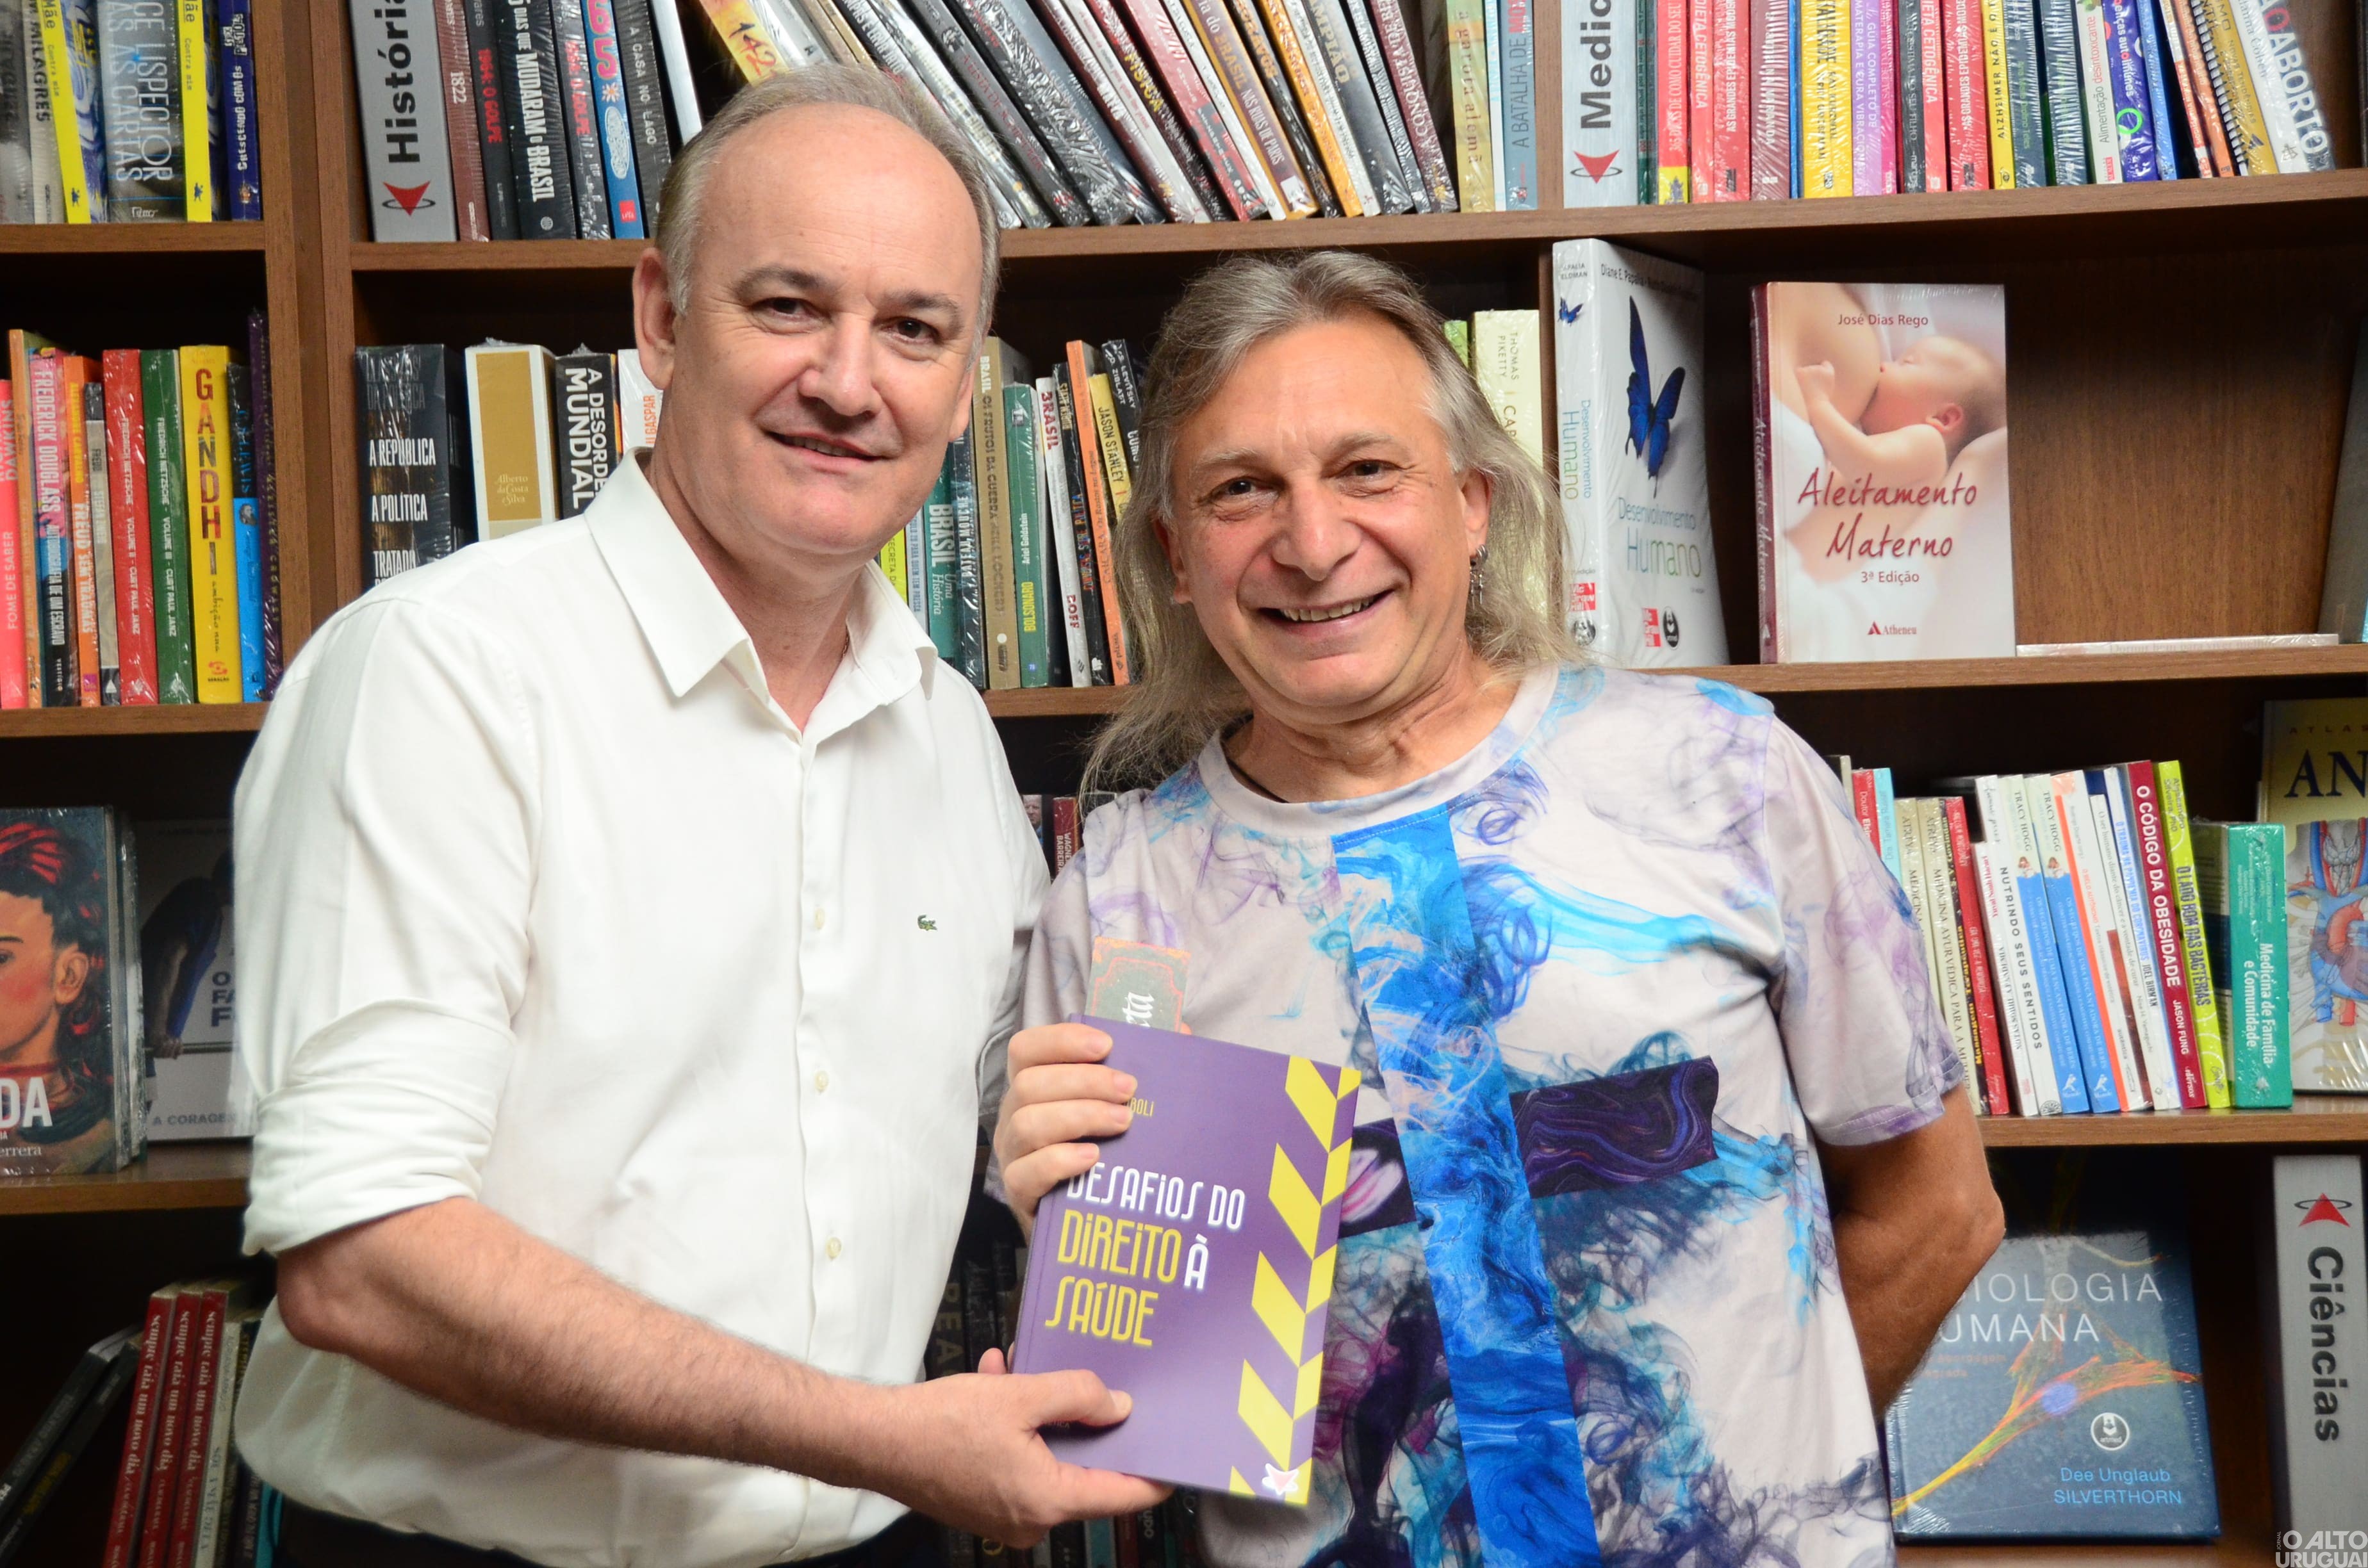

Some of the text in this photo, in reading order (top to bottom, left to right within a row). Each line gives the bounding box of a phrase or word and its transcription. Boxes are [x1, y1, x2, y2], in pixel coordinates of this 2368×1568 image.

[514, 6, 529, 30] DIAS
[1668, 3, 1681, 18] SEU
[1668, 20, 1681, 33] DO
[516, 31, 532, 51] QUE
[1455, 29, 1476, 95] garota
[1668, 36, 1681, 68] CUIDAR
[27, 20, 51, 122] MILAGRES
[373, 0, 421, 165] Históri
[450, 70, 467, 103] 1822
[477, 47, 503, 144] 1964: O GOLPE
[515, 52, 547, 135] MUDARAM
[629, 26, 657, 145] A CASA NO LAGO
[1205, 13, 1286, 166] do BRASIL NAS RUAS DE PARIS
[1508, 38, 1529, 148] A BATALHA DE
[1668, 69, 1681, 95] COMO
[1725, 30, 1736, 131] AS GRANDES EPIDEMIAS
[1866, 22, 1876, 127] GUIA COMPLETO DE
[2085, 15, 2112, 143] Alimentação desintoxicante
[2269, 27, 2330, 156] ABORTO
[135, 43, 173, 181] LISPECTOR
[1668, 98, 1682, 109] DE
[108, 85, 144, 182] CARTAS
[1463, 102, 1484, 164] alemã
[1670, 137, 1682, 151] 365
[526, 144, 555, 202] BRASIL
[1838, 314, 1928, 327] José Dias Rego
[1498, 335, 1507, 377] PIKETTY
[1509, 332, 1519, 380] THOMAS
[33, 370, 56, 441] FREDERICK
[1039, 390, 1060, 450] BRASIL
[2, 400, 17, 480] DAWKINS
[120, 418, 130, 459] FRIEDRICH
[156, 417, 167, 459] FRIEDRICH
[370, 438, 436, 466] A REPÚBLICA
[559, 367, 600, 509] MUNDIAL
[585, 367, 613, 495] A DESORDE
[1098, 405, 1124, 483] JASON STANLEY
[1561, 411, 1583, 500] Humano
[1579, 400, 1595, 498] Desenvolvimento
[38, 445, 60, 512] DOUGLASS
[122, 461, 133, 505] NIETZSCHE
[159, 460, 169, 504] NIETZSCHE
[195, 368, 222, 575] GANDHI
[497, 475, 528, 484] Alberto
[1798, 468, 1977, 506] Aleitamento
[372, 494, 427, 522] A POLÍTICA
[126, 517, 135, 550] VOLUME
[162, 516, 172, 550] VOLUME
[928, 503, 956, 598] BRASIL Uma
[1017, 512, 1032, 564] Ariel Goldstein
[1627, 527, 1702, 578] Humano
[1826, 513, 1953, 561] Materno
[3, 531, 18, 628] FOME DE SABER
[129, 566, 138, 589] CURT
[130, 591, 139, 611] PAUL
[165, 568, 174, 590] CURT
[930, 572, 945, 615] História
[1861, 569, 1920, 585] 3ª Edição
[131, 612, 140, 634] JANZ
[167, 592, 176, 613] PAUL
[168, 614, 177, 636] JANZ
[1019, 581, 1038, 632] BOLSONARO
[50, 611, 65, 645] ESCRAVO
[1883, 625, 1917, 635] Atheneu
[2014, 790, 2032, 851] TRACY HOGG
[2043, 790, 2061, 851] TRACY HOGG
[2178, 874, 2194, 901] LADO
[2135, 785, 2190, 1055] O CÓDIGO DA OBESIDADE JASON FUNG
[2182, 903, 2199, 926] BOM
[2185, 927, 2202, 949] DAS
[1999, 867, 2042, 1049] NUTRINDO SEUS SENTIDOS
[2189, 949, 2212, 1006] BACTÉRIAS
[2255, 942, 2278, 998] Medicina
[2239, 970, 2264, 1047] Comunidade
[2260, 1000, 2275, 1017] de
[2258, 1019, 2280, 1065] Família
[1067, 1162, 1246, 1230] DESAFIOS DO
[1057, 1209, 1209, 1289] DIREITO À
[1045, 1275, 1158, 1346] SAÚDE
[1964, 1273, 2163, 1302] IOLOGIA
[1939, 1313, 2100, 1343] UMANA
[2303, 1245, 2355, 1441] Ciências
[2054, 1489, 2182, 1505] SILVERTHORN
[2060, 1467, 2170, 1485] Dee Unglaub
